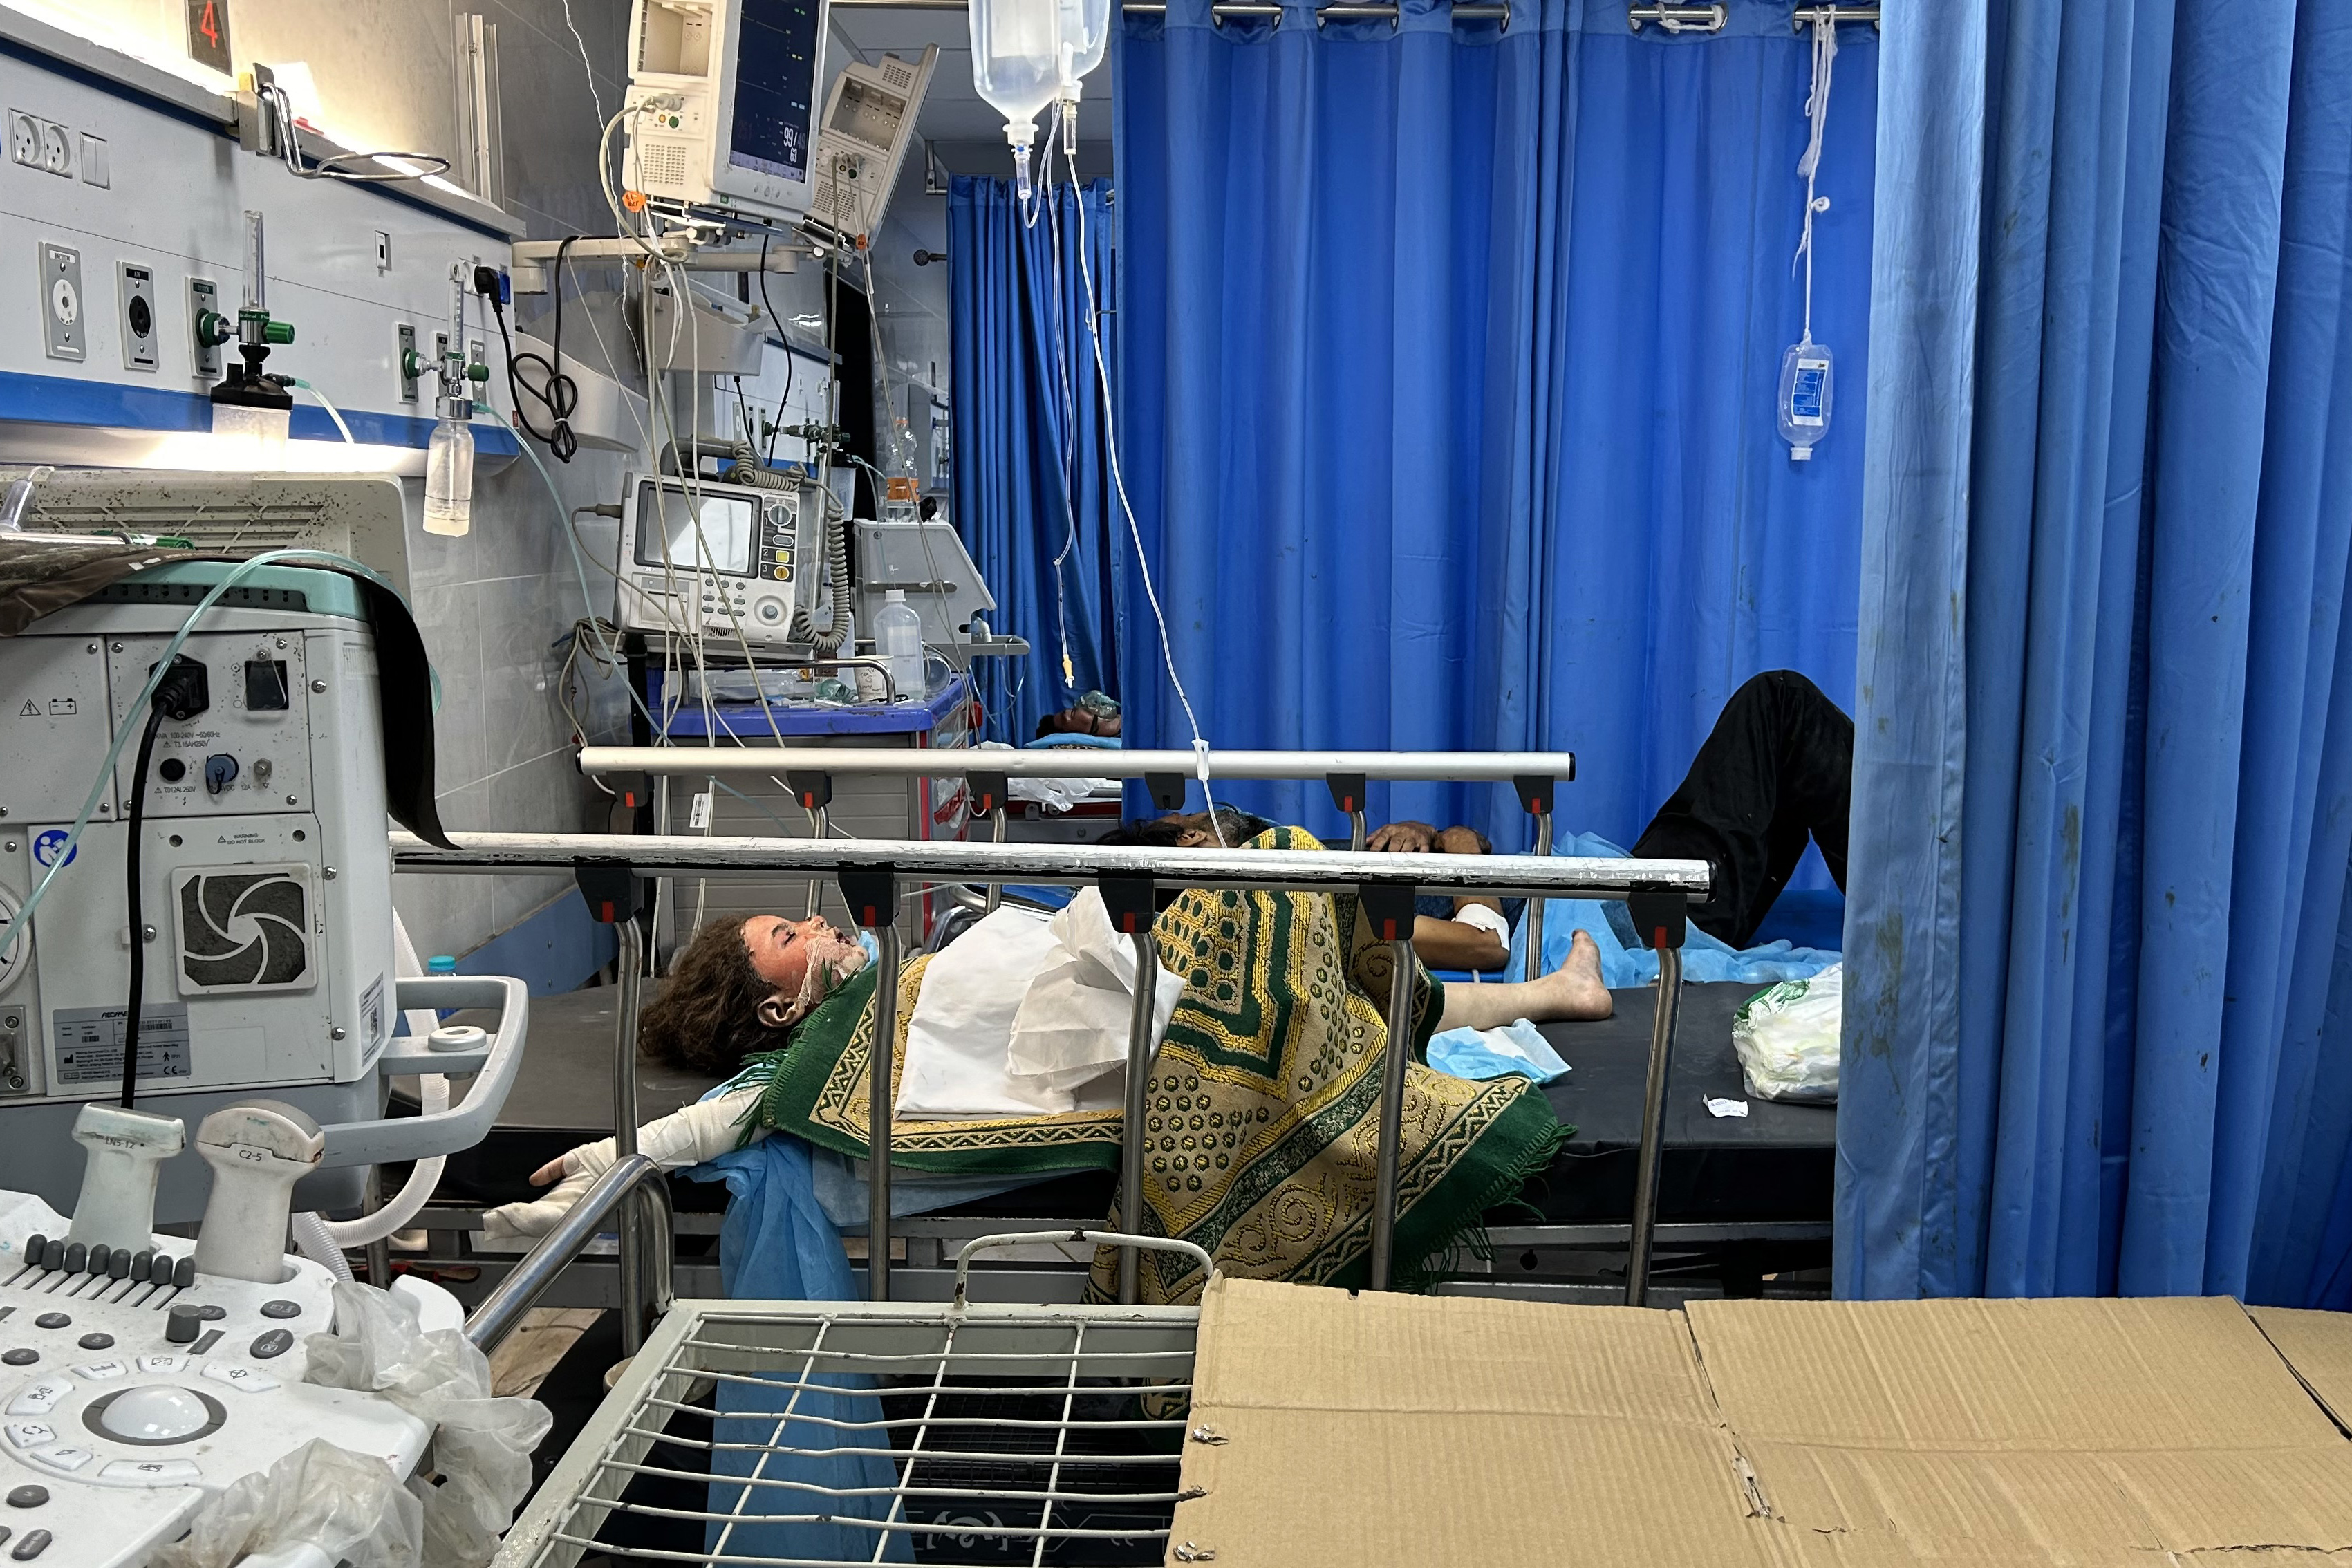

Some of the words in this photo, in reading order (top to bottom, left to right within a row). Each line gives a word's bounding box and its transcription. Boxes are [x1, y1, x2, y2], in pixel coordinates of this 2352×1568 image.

[201, 1, 218, 48] 4
[763, 548, 769, 557] 2
[762, 563, 768, 572] 3
[239, 1150, 263, 1161] C2-5
